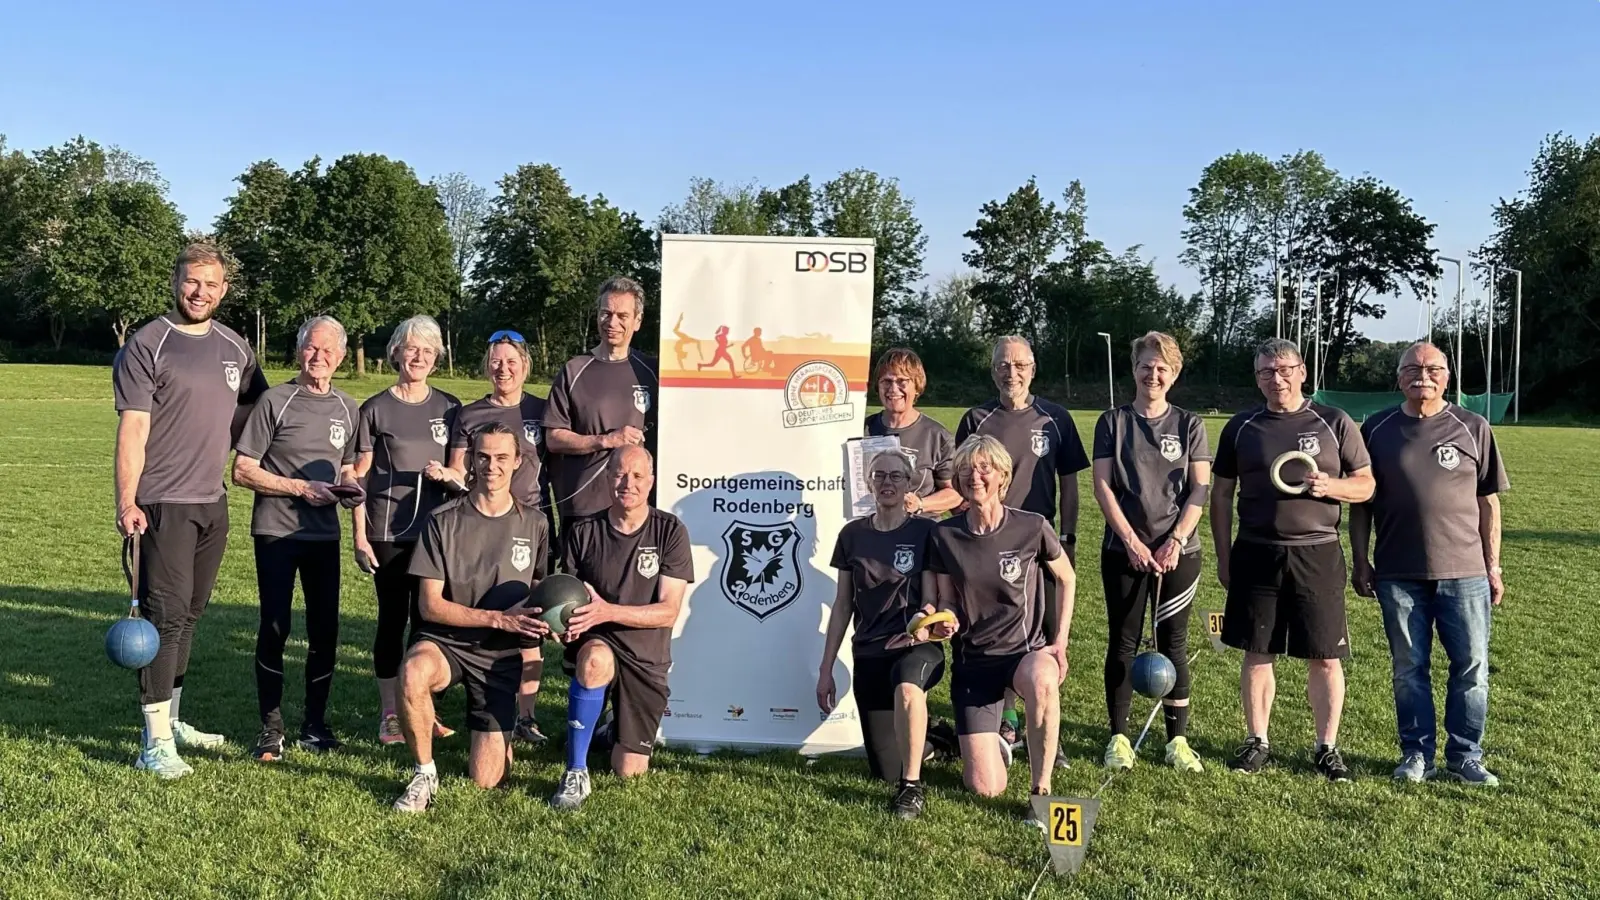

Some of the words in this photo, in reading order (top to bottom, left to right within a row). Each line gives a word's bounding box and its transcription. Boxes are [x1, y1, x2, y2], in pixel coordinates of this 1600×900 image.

[795, 251, 867, 273] DOSB
[676, 473, 846, 493] Sportgemeinschaft
[712, 498, 815, 517] Rodenberg
[741, 531, 752, 546] S
[768, 531, 784, 547] G
[731, 580, 795, 605] Rodenberg
[1210, 615, 1225, 633] 30
[1054, 807, 1077, 842] 25
